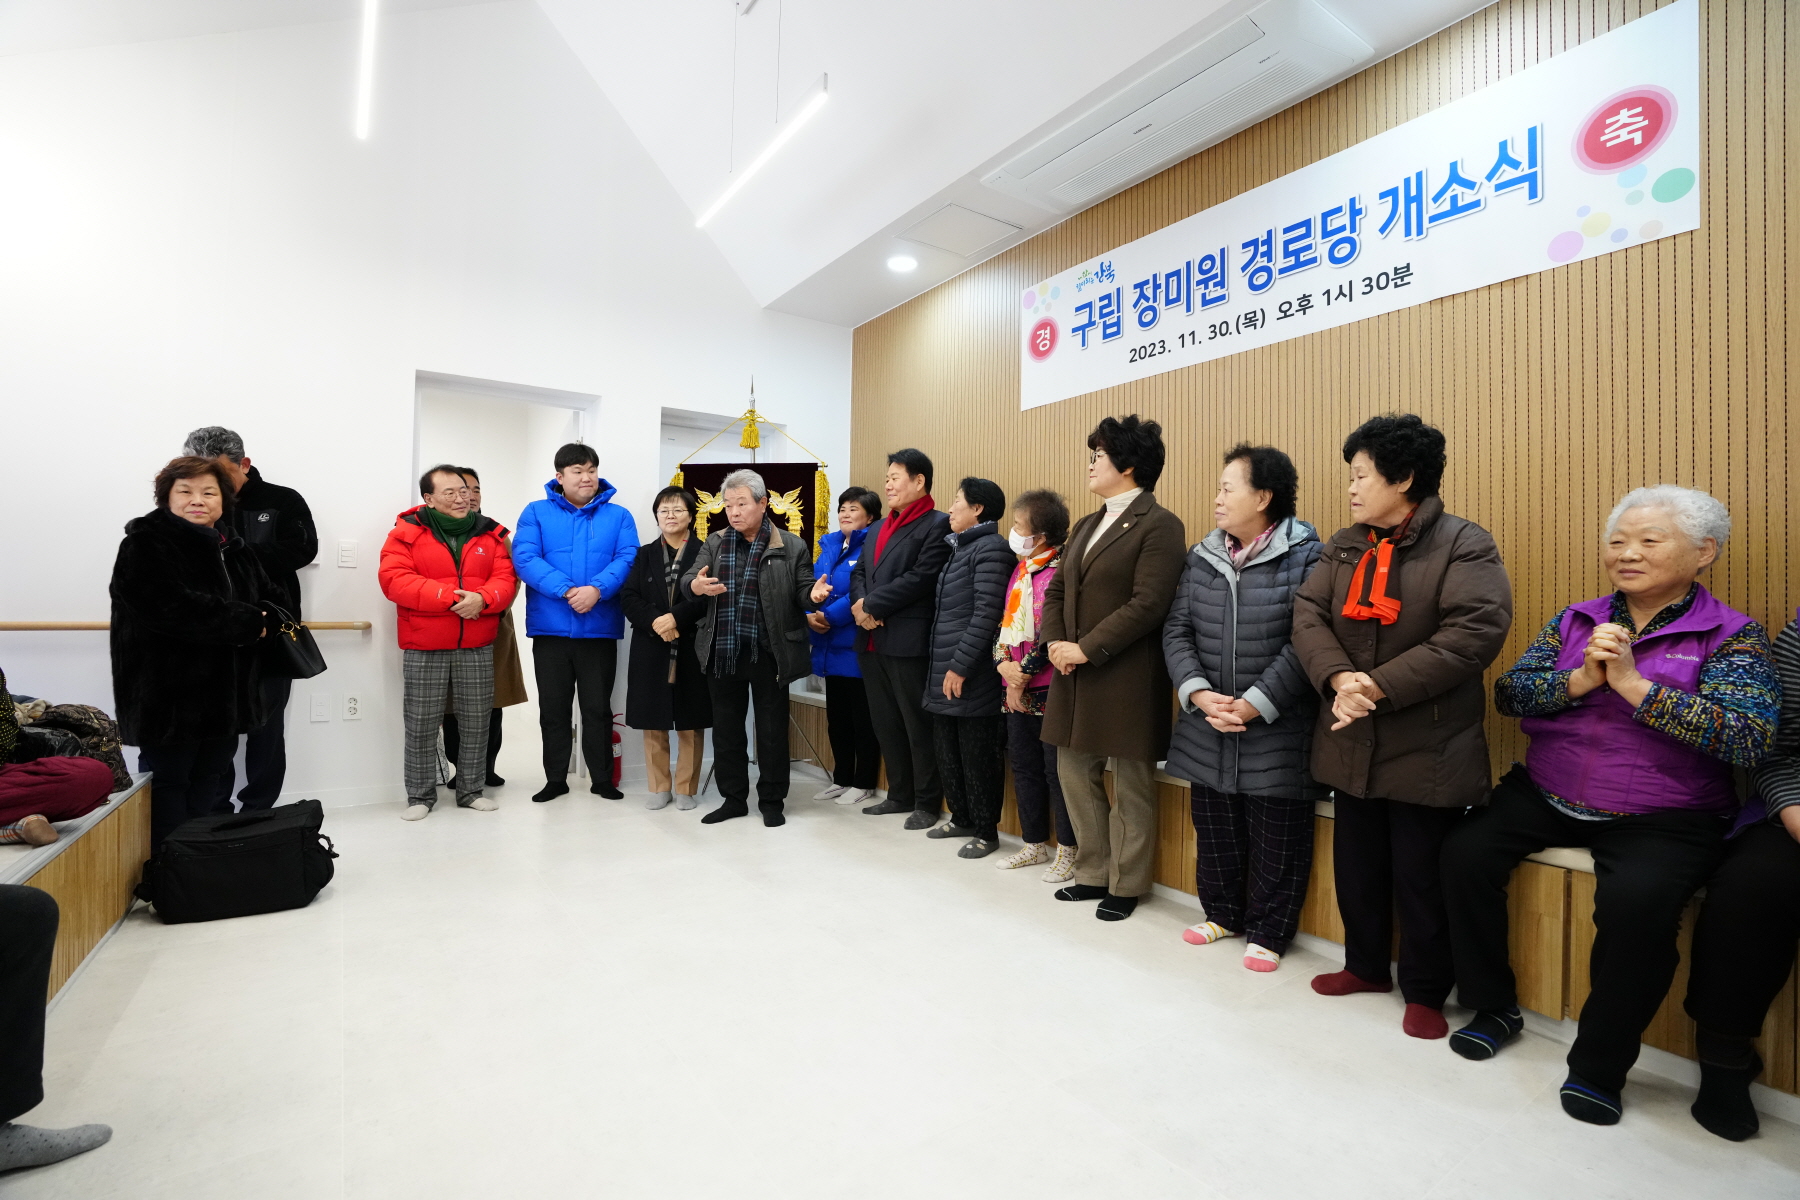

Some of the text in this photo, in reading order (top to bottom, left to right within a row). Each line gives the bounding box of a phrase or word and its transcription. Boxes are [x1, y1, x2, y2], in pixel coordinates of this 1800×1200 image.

[1600, 106, 1649, 148] 축
[1071, 125, 1539, 348] 구립 장미원 경로당 개소식
[1094, 260, 1115, 284] 강북
[1129, 339, 1171, 363] 2023.
[1178, 330, 1202, 348] 11.
[1276, 293, 1314, 320] 오후
[1322, 280, 1353, 306] 1시
[1361, 262, 1413, 295] 30분
[1036, 326, 1050, 351] 경
